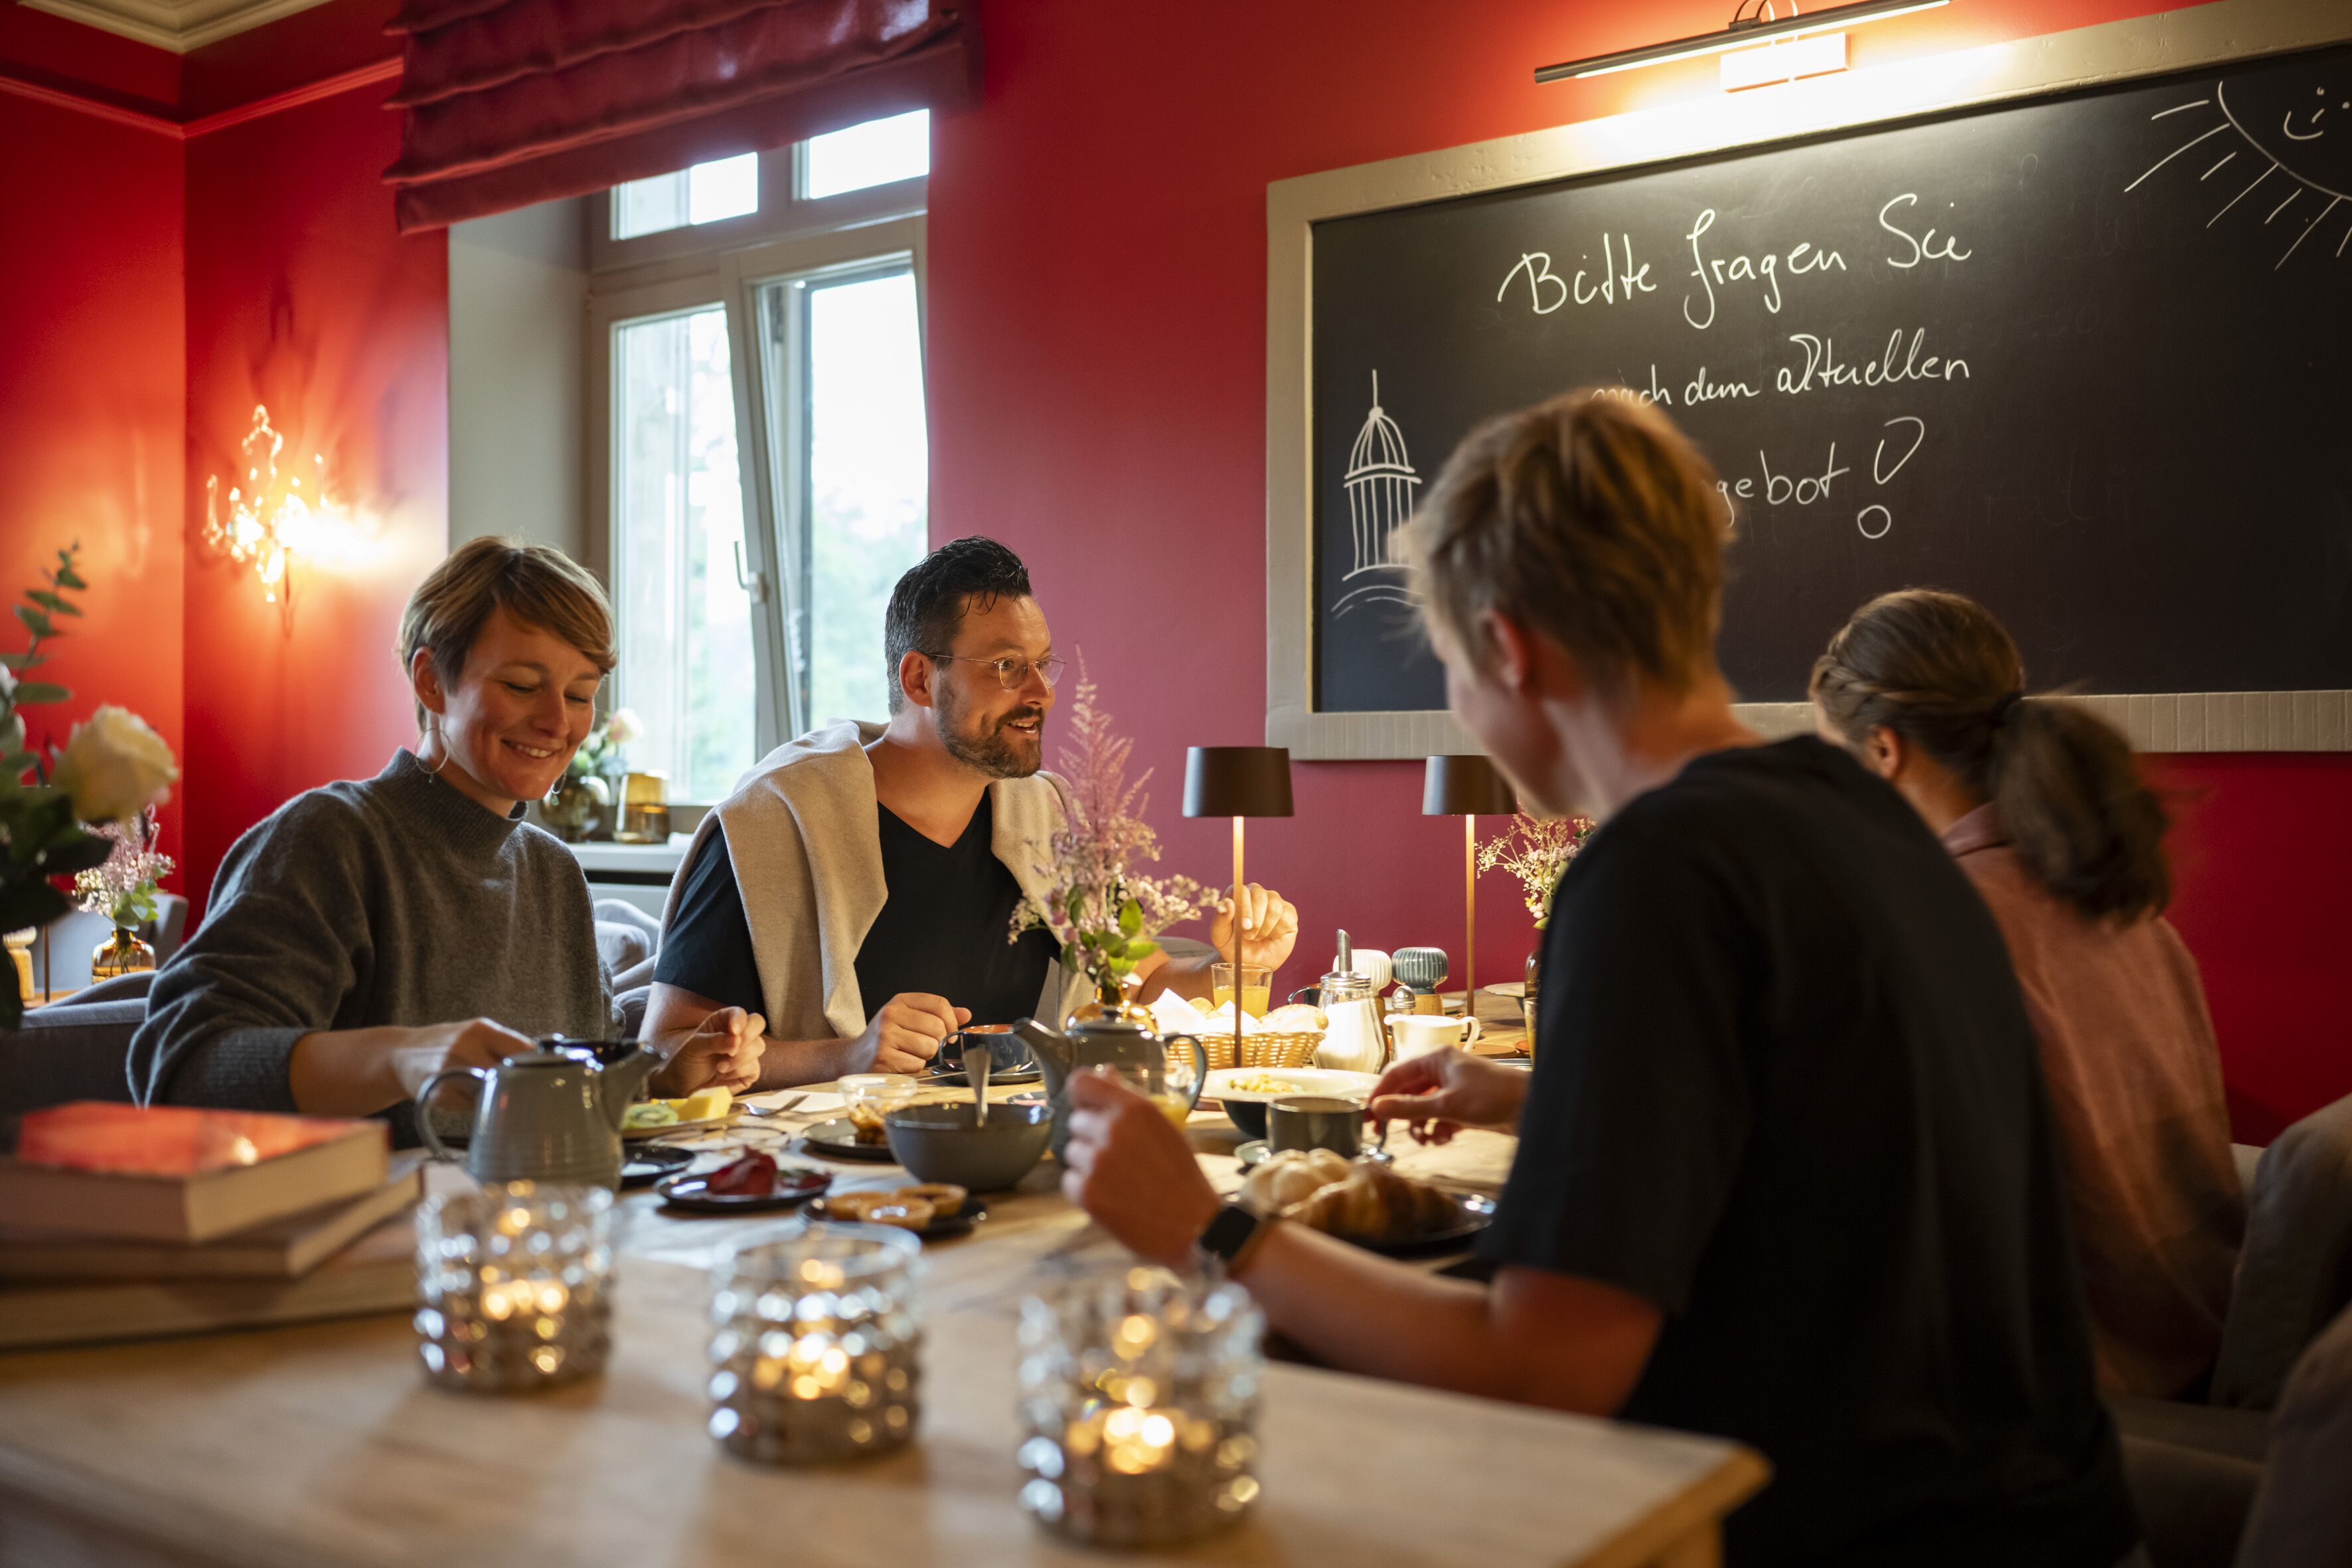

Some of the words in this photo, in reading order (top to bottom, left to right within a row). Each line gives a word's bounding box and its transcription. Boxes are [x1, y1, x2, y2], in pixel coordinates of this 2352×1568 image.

[1496, 232, 1658, 315] Bitte
[1684, 208, 1847, 330] fragen
[1879, 193, 1972, 268] Sie
[1684, 366, 1760, 407] dem
[1777, 327, 1970, 395] aktuellen
